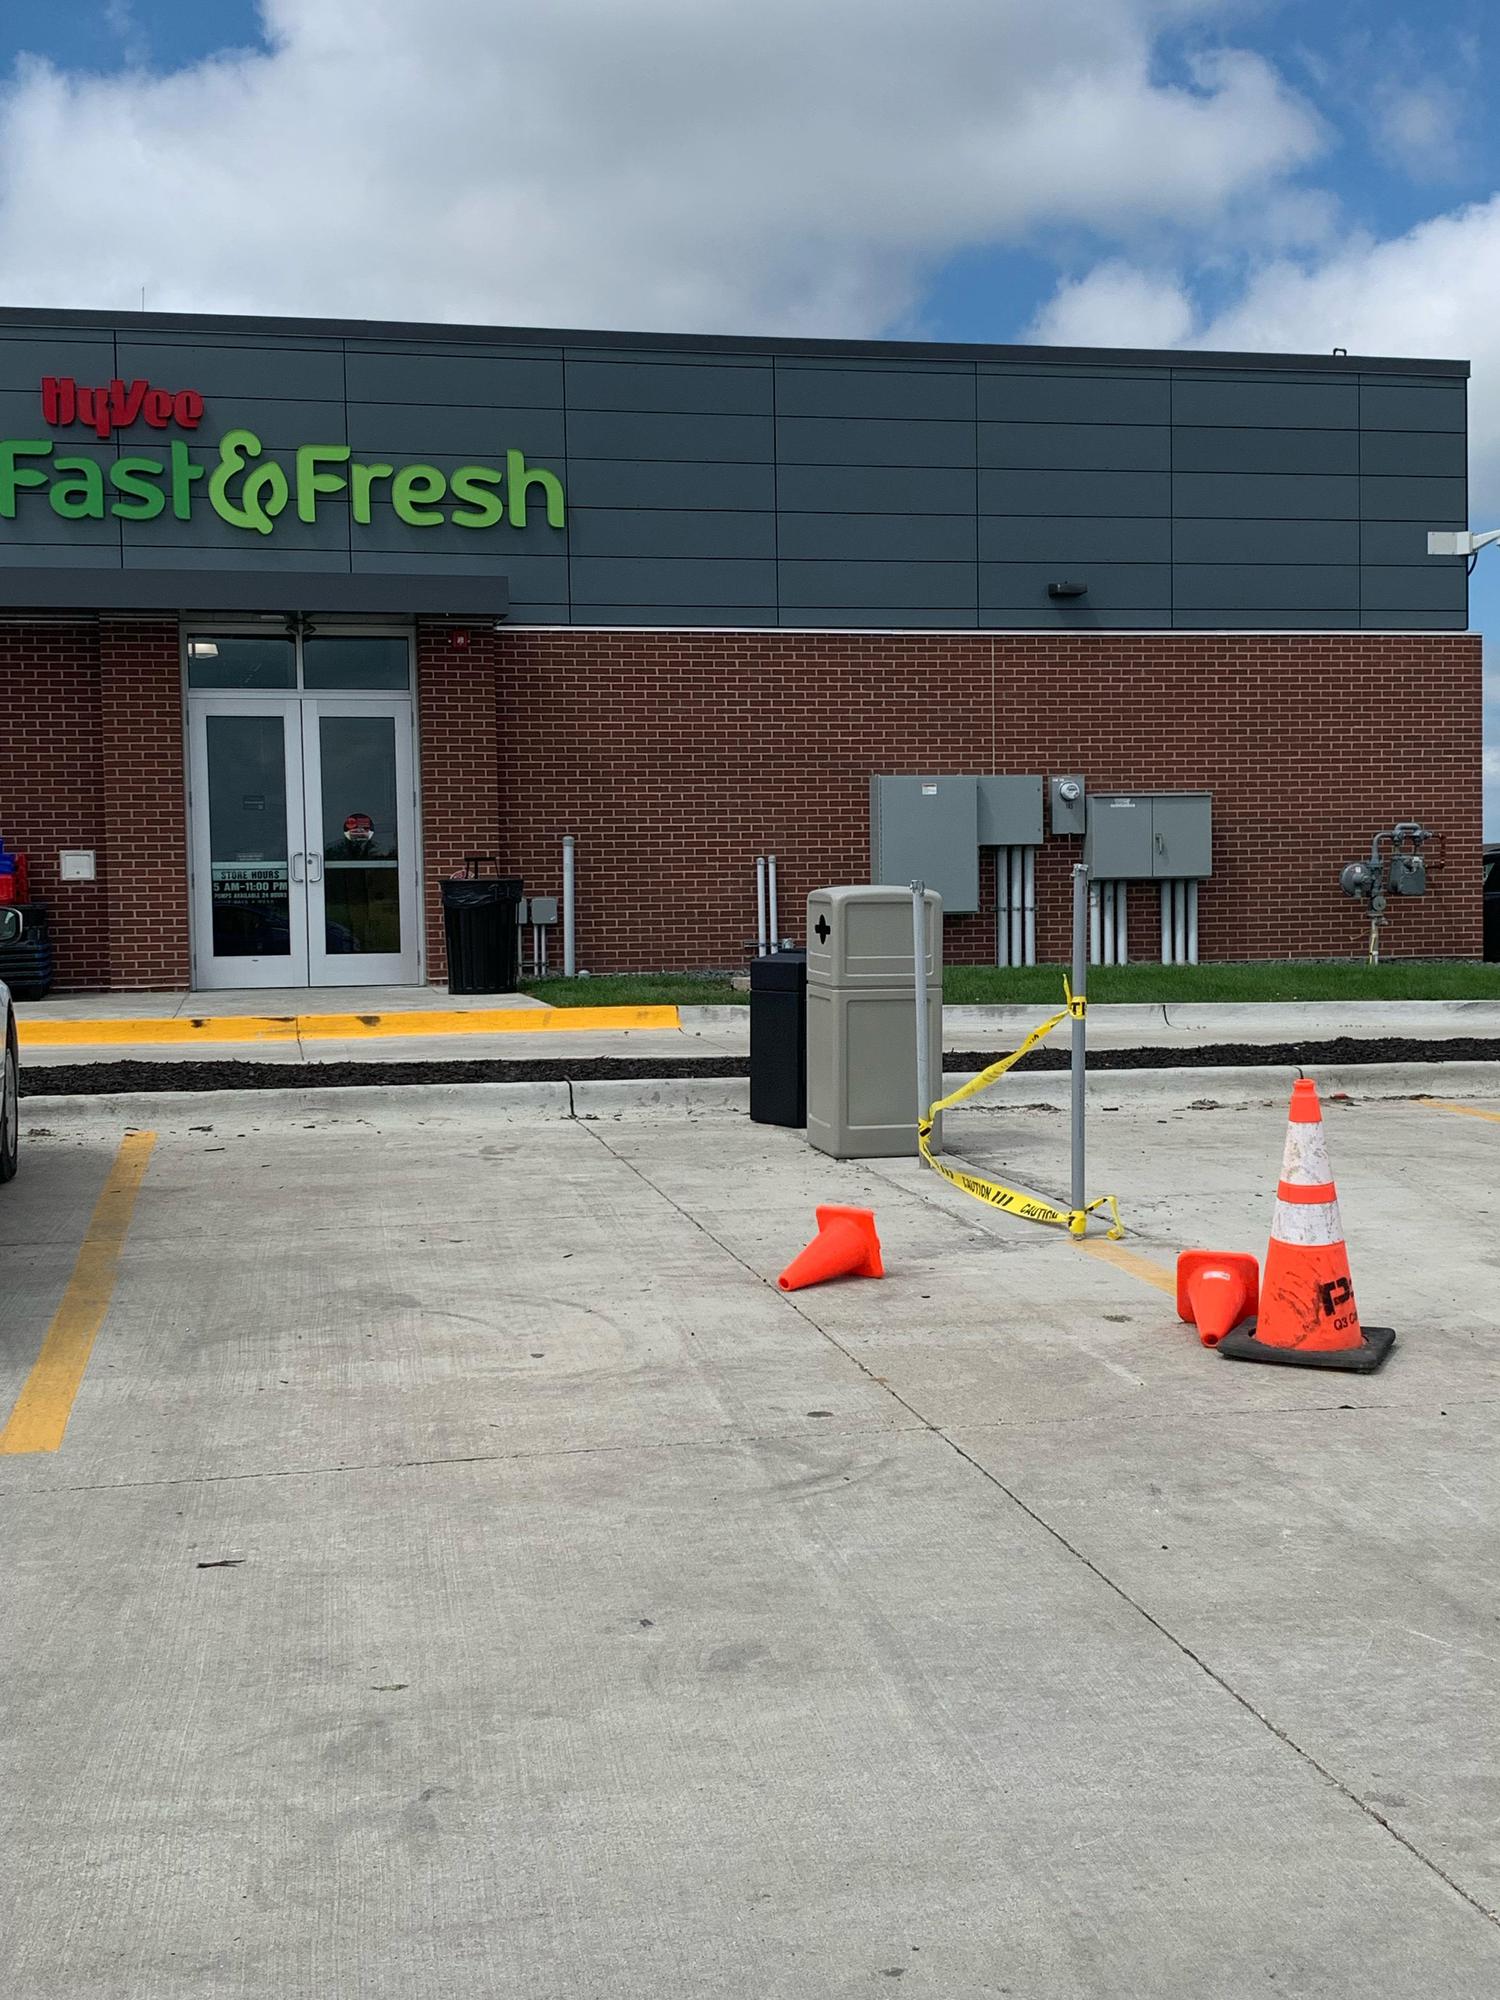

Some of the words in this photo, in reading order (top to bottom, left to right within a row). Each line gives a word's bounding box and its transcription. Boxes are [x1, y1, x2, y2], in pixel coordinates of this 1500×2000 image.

[0, 440, 204, 520] Fast
[296, 445, 566, 528] Fresh
[221, 871, 248, 880] STORE
[251, 870, 280, 879] HOURS
[273, 881, 288, 891] PM
[961, 1175, 992, 1200] CAUTION
[1333, 1316, 1349, 1331] Q3
